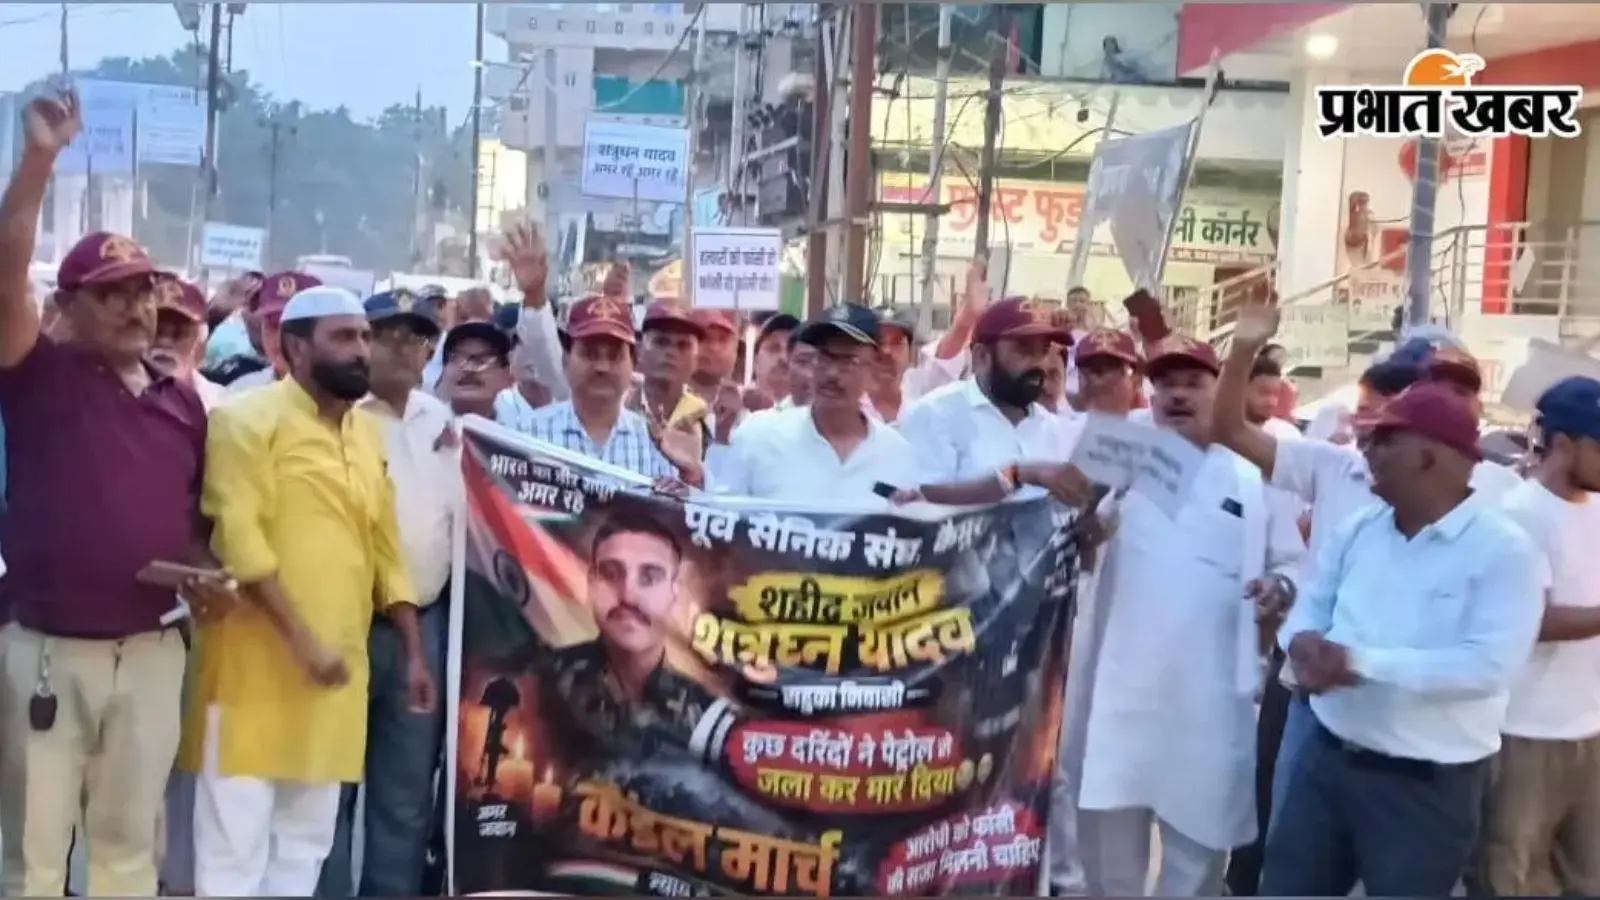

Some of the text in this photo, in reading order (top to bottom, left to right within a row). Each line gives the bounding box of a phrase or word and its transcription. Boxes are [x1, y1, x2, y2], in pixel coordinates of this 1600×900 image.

[643, 148, 677, 162] यादव
[490, 454, 528, 475] भारत
[518, 480, 559, 506] अमर
[748, 511, 856, 562] सैनिक
[758, 576, 921, 622] शहीद जवान
[692, 612, 848, 683] शत्रुघ्न
[858, 607, 976, 673] यादव
[840, 679, 905, 709] निवासी
[743, 731, 787, 765] कुछ
[791, 728, 854, 770] दरिंदों
[857, 732, 877, 769] ने
[757, 762, 954, 806] जला कर मार दिया
[717, 829, 842, 897] मार्च
[992, 833, 1041, 867] चाहिए
